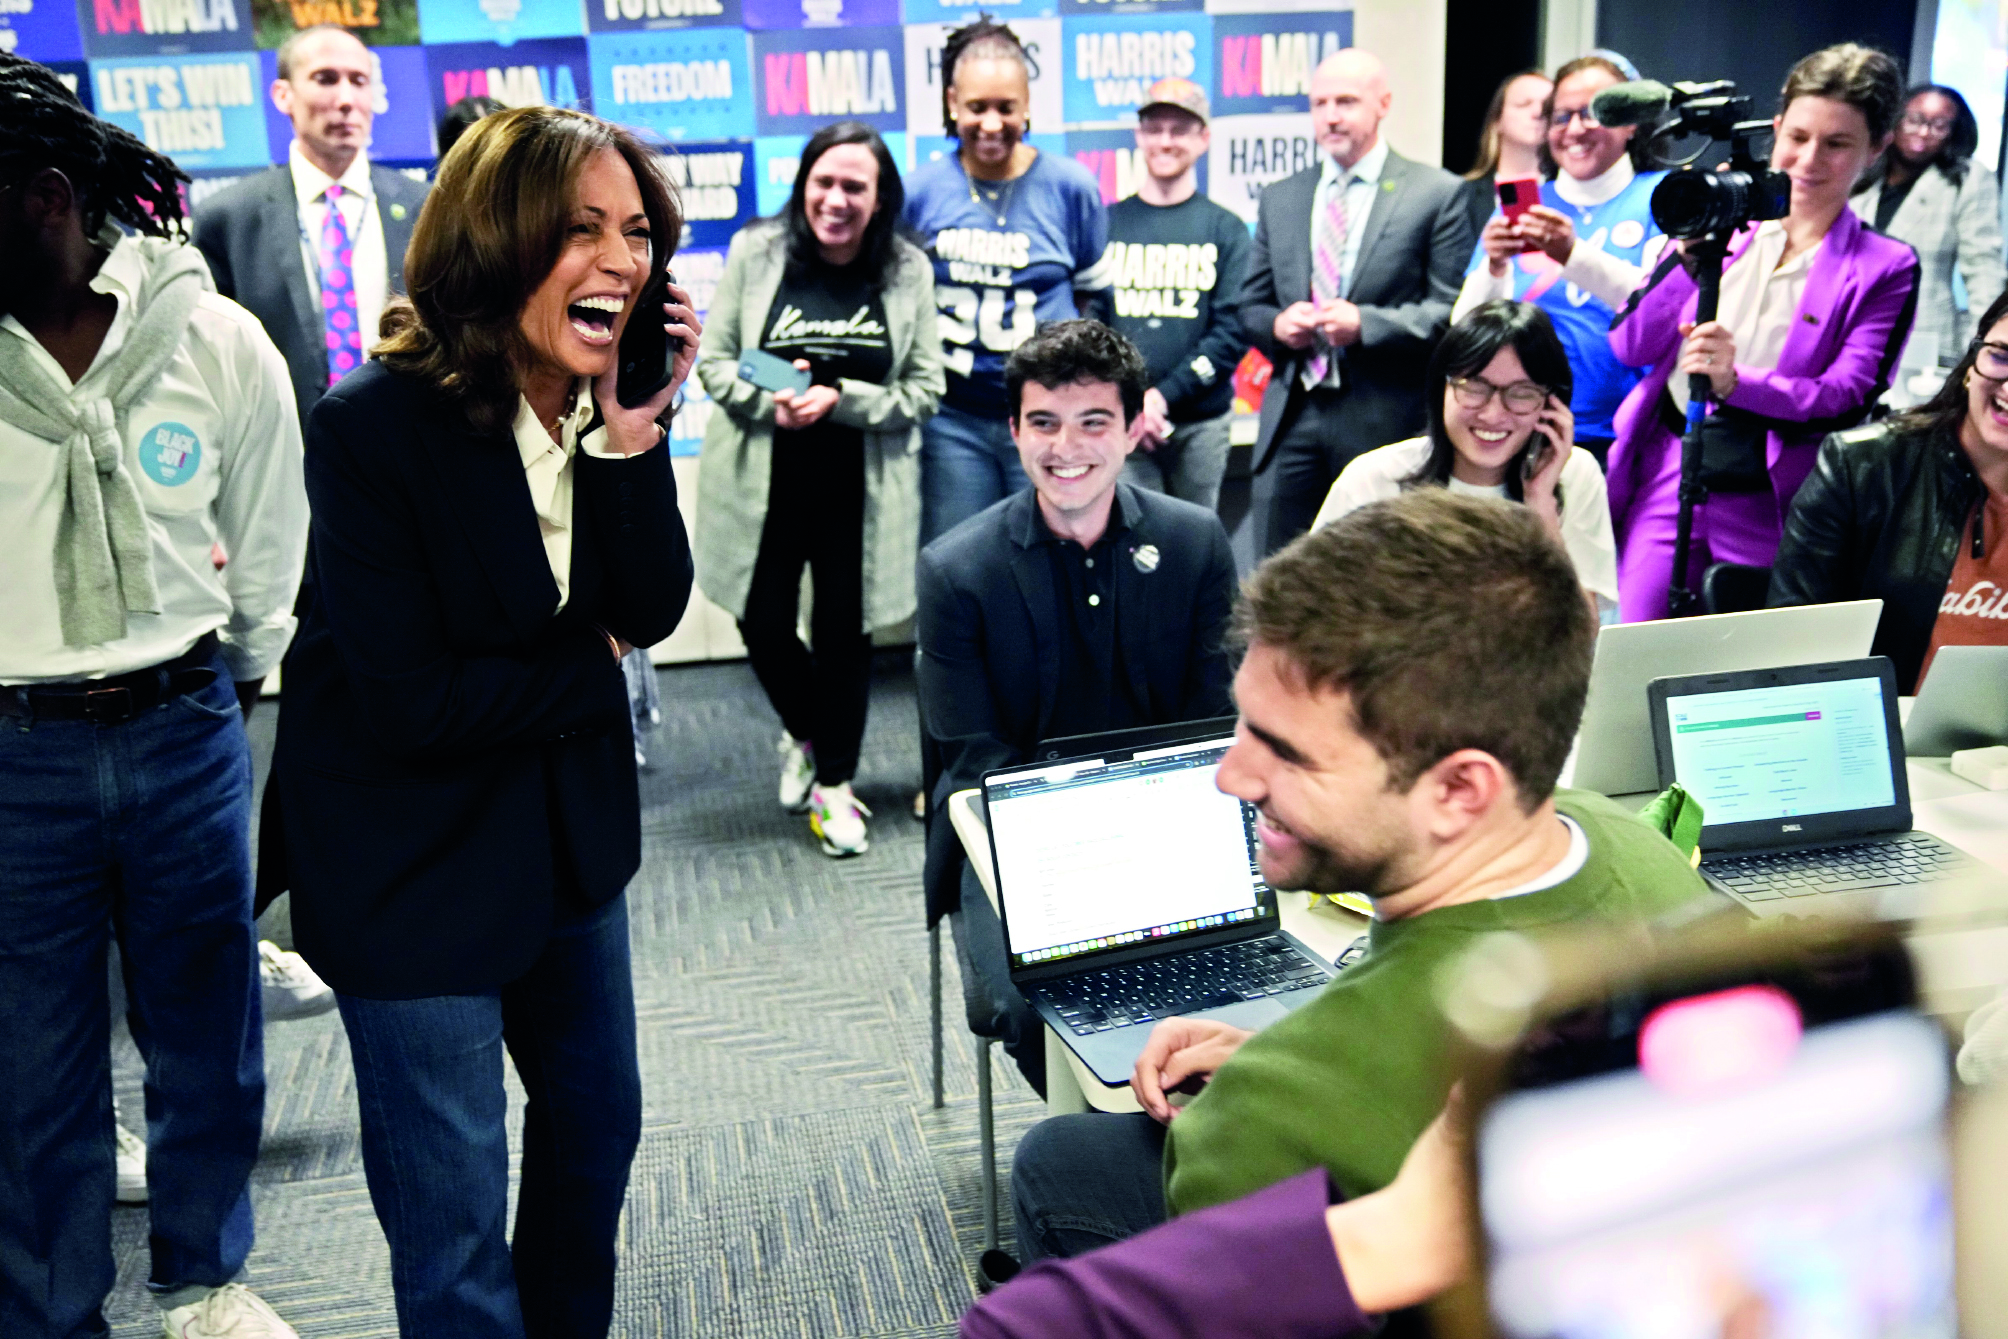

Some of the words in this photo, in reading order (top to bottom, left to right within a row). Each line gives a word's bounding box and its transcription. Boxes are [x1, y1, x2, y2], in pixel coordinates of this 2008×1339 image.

[1076, 30, 1196, 81] HARRIS
[98, 65, 182, 113] LET'S
[180, 62, 254, 107] WIN
[611, 59, 733, 104] FREEDOM
[765, 49, 897, 116] KAMALA
[1231, 136, 1319, 174] HARRI
[936, 227, 1031, 269] HARRIS
[949, 260, 1013, 286] WALZ
[769, 304, 886, 340] Kamala
[1114, 288, 1200, 318] WALZ
[155, 427, 196, 455] BLACK
[157, 447, 187, 468] JOY!
[1938, 580, 2008, 620] abi
